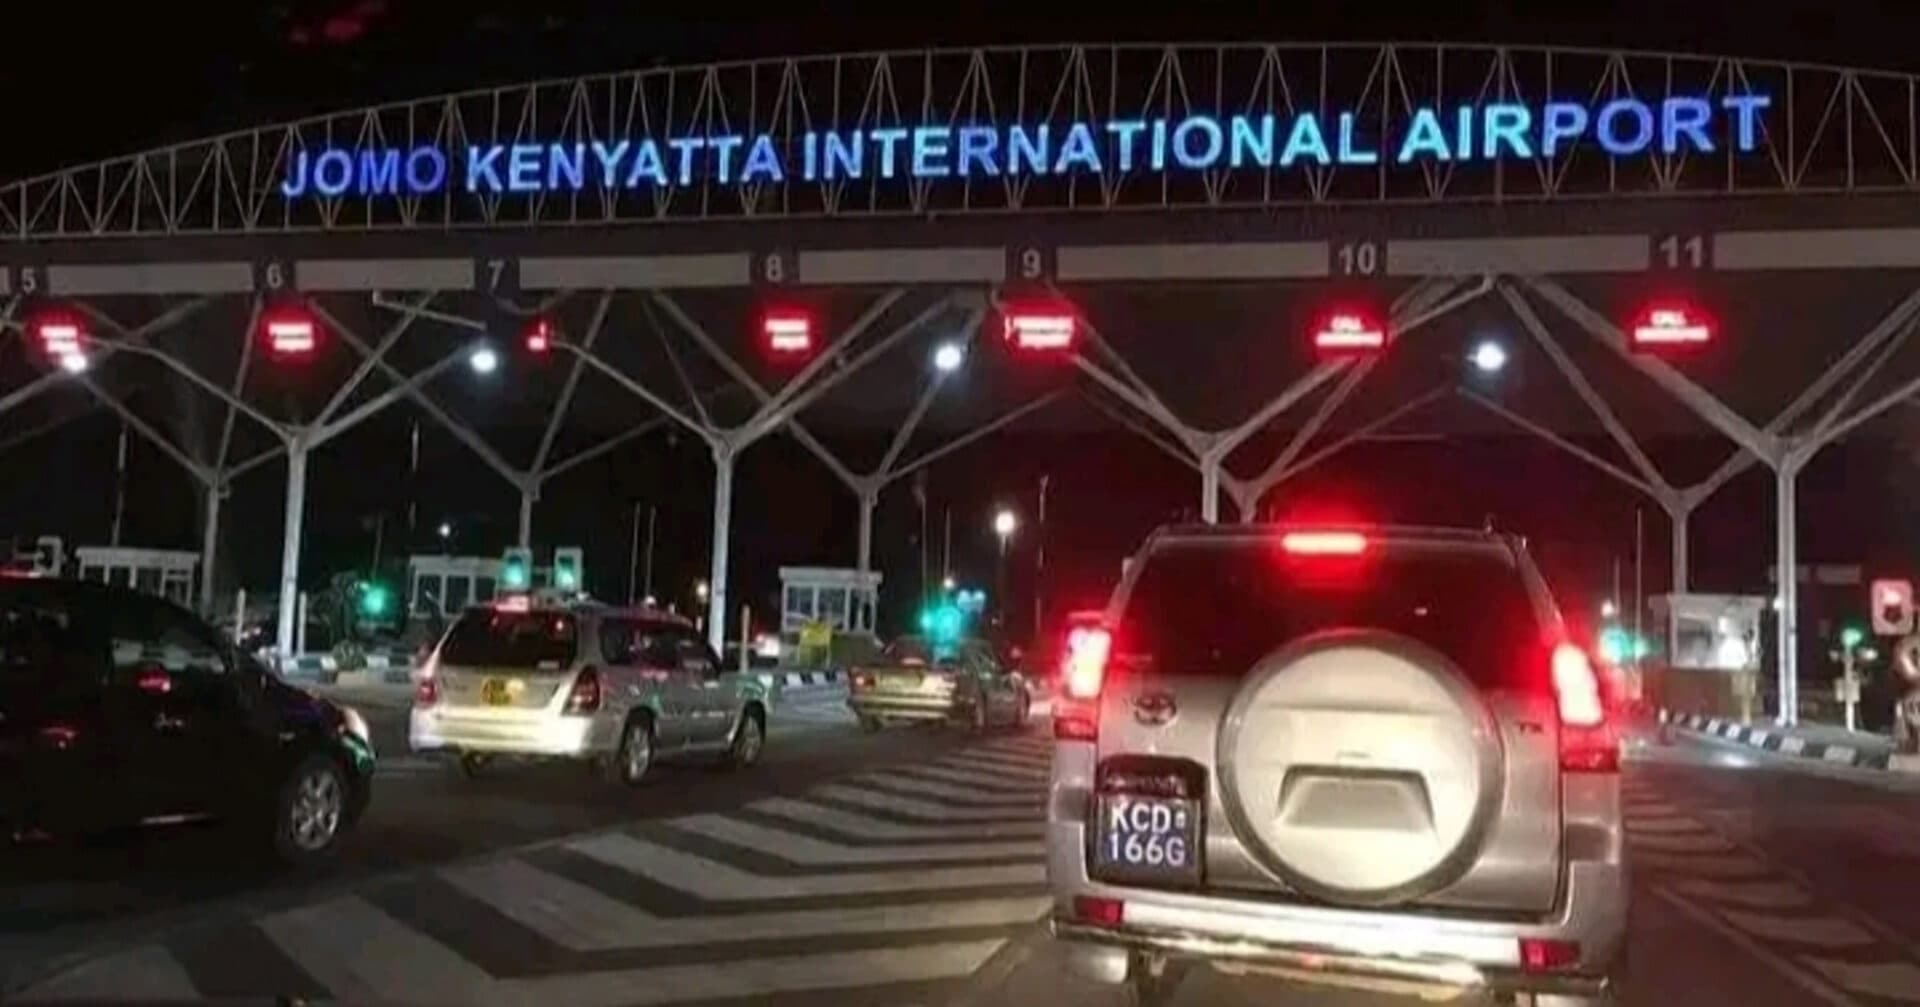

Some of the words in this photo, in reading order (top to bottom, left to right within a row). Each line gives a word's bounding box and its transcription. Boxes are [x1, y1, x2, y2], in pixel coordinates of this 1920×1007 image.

[282, 147, 446, 197] JOMO
[467, 135, 783, 191] KENYATTA
[803, 112, 1377, 181] INTERNATIONAL
[1398, 95, 1771, 162] AIRPORT
[1023, 249, 1041, 279] 9
[1338, 244, 1376, 275] 10
[1660, 236, 1704, 268] 11
[20, 266, 36, 294] 5
[266, 262, 285, 289] 6
[487, 260, 505, 289] 7
[764, 254, 784, 283] 8
[1111, 802, 1171, 834] KCD
[1109, 833, 1185, 867] 166G
